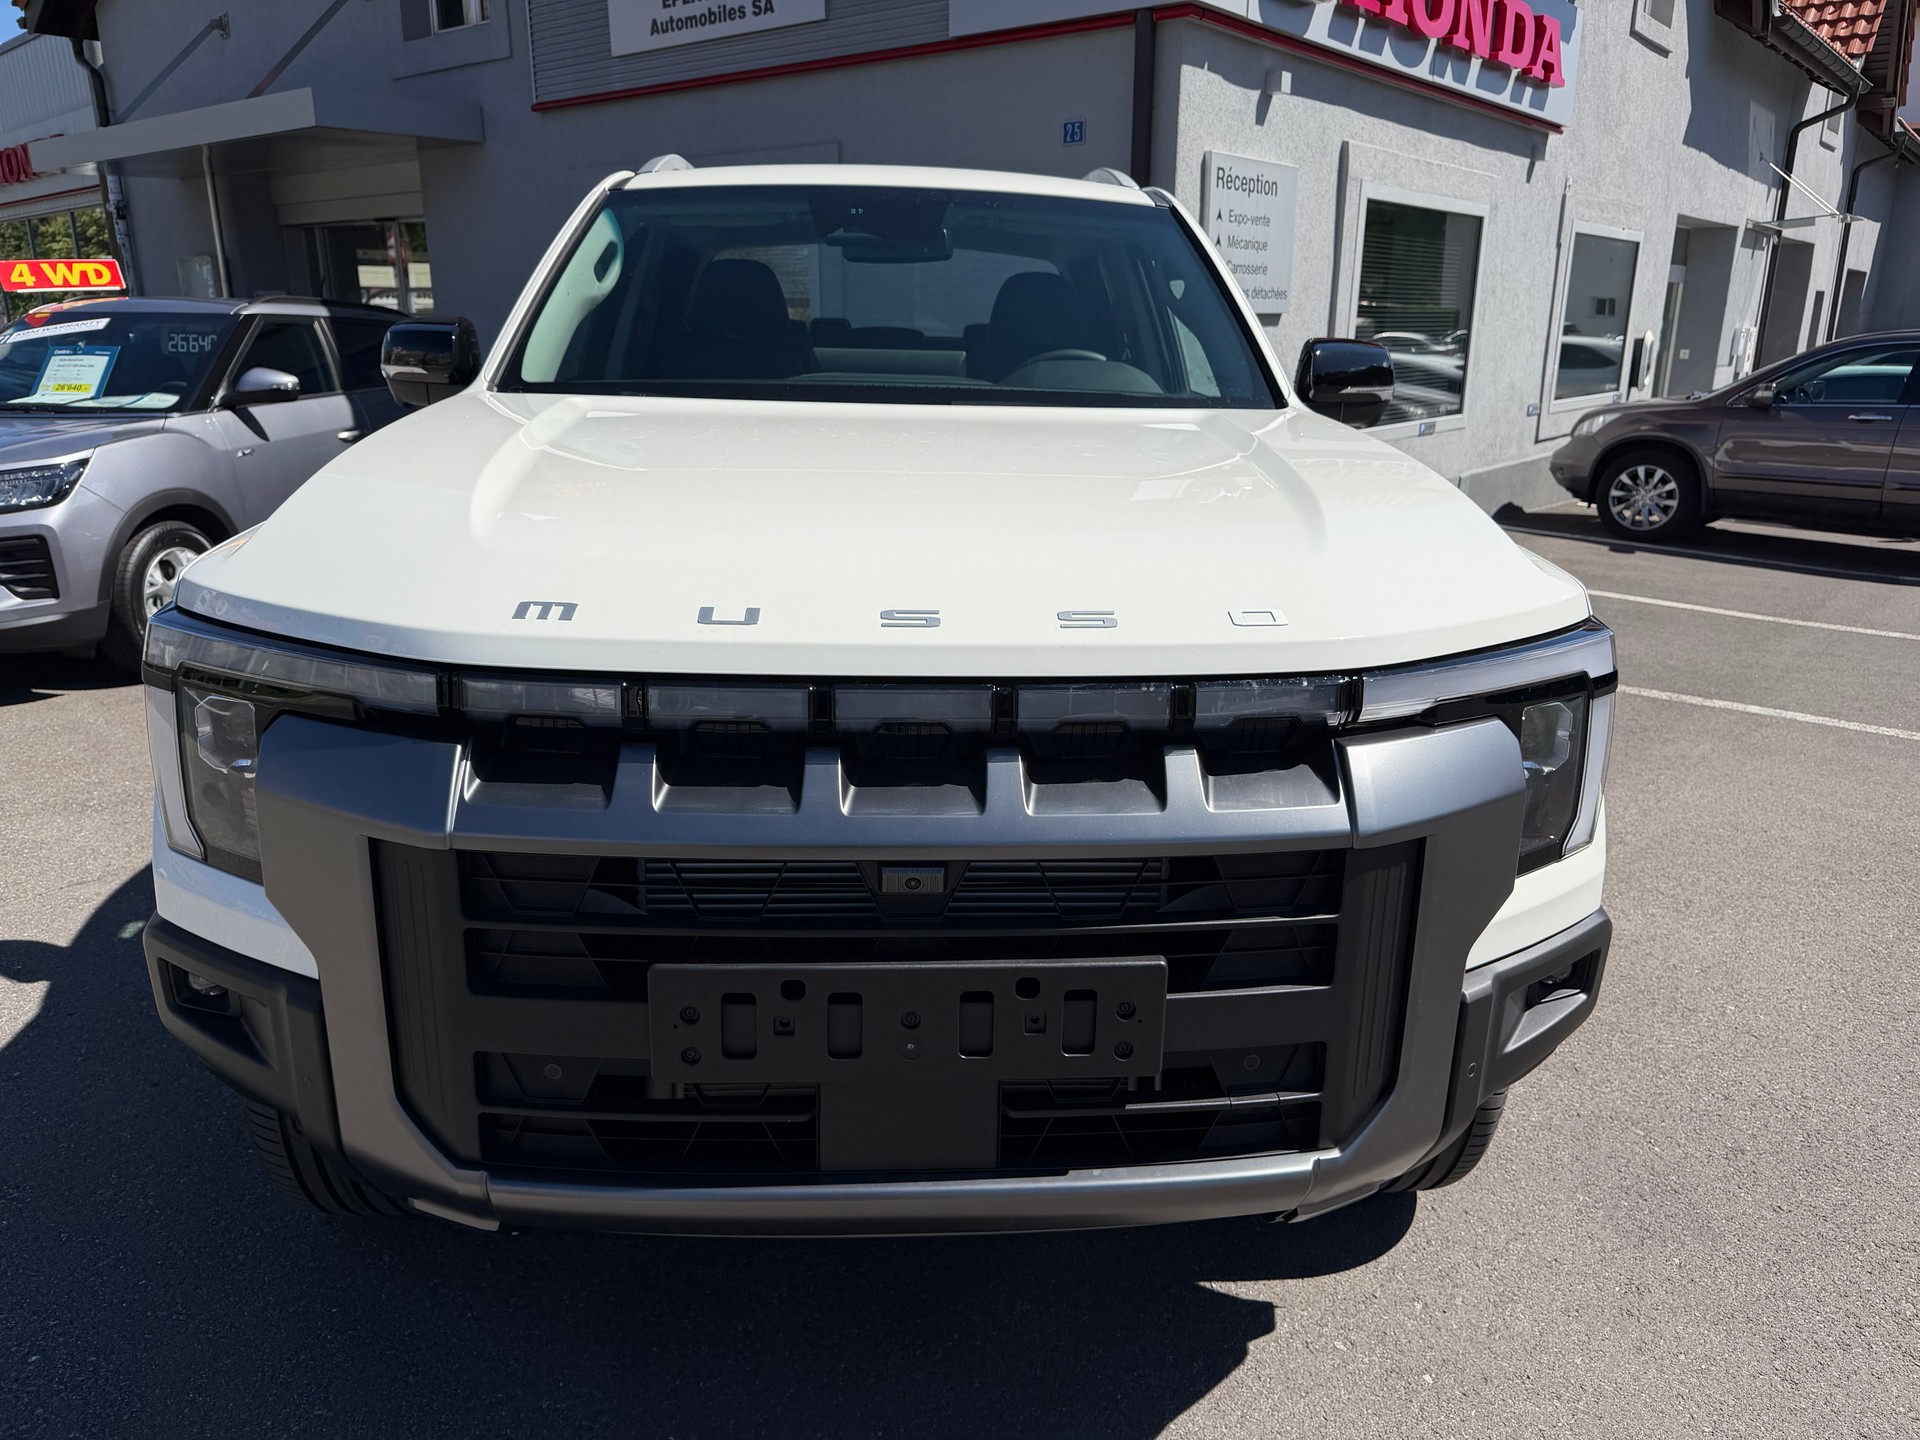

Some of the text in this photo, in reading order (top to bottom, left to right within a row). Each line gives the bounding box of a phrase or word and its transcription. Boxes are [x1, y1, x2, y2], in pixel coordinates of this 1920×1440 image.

[650, 4, 746, 36] Automobiles
[752, 0, 775, 16] SA
[1345, 0, 1565, 87] ONDA
[1066, 122, 1080, 142] 25
[1216, 166, 1278, 198] Réception
[1228, 209, 1271, 227] Expo-vente
[1227, 235, 1268, 254] Mécanique
[10, 262, 111, 287] 4 WD
[1251, 286, 1287, 300] détachées
